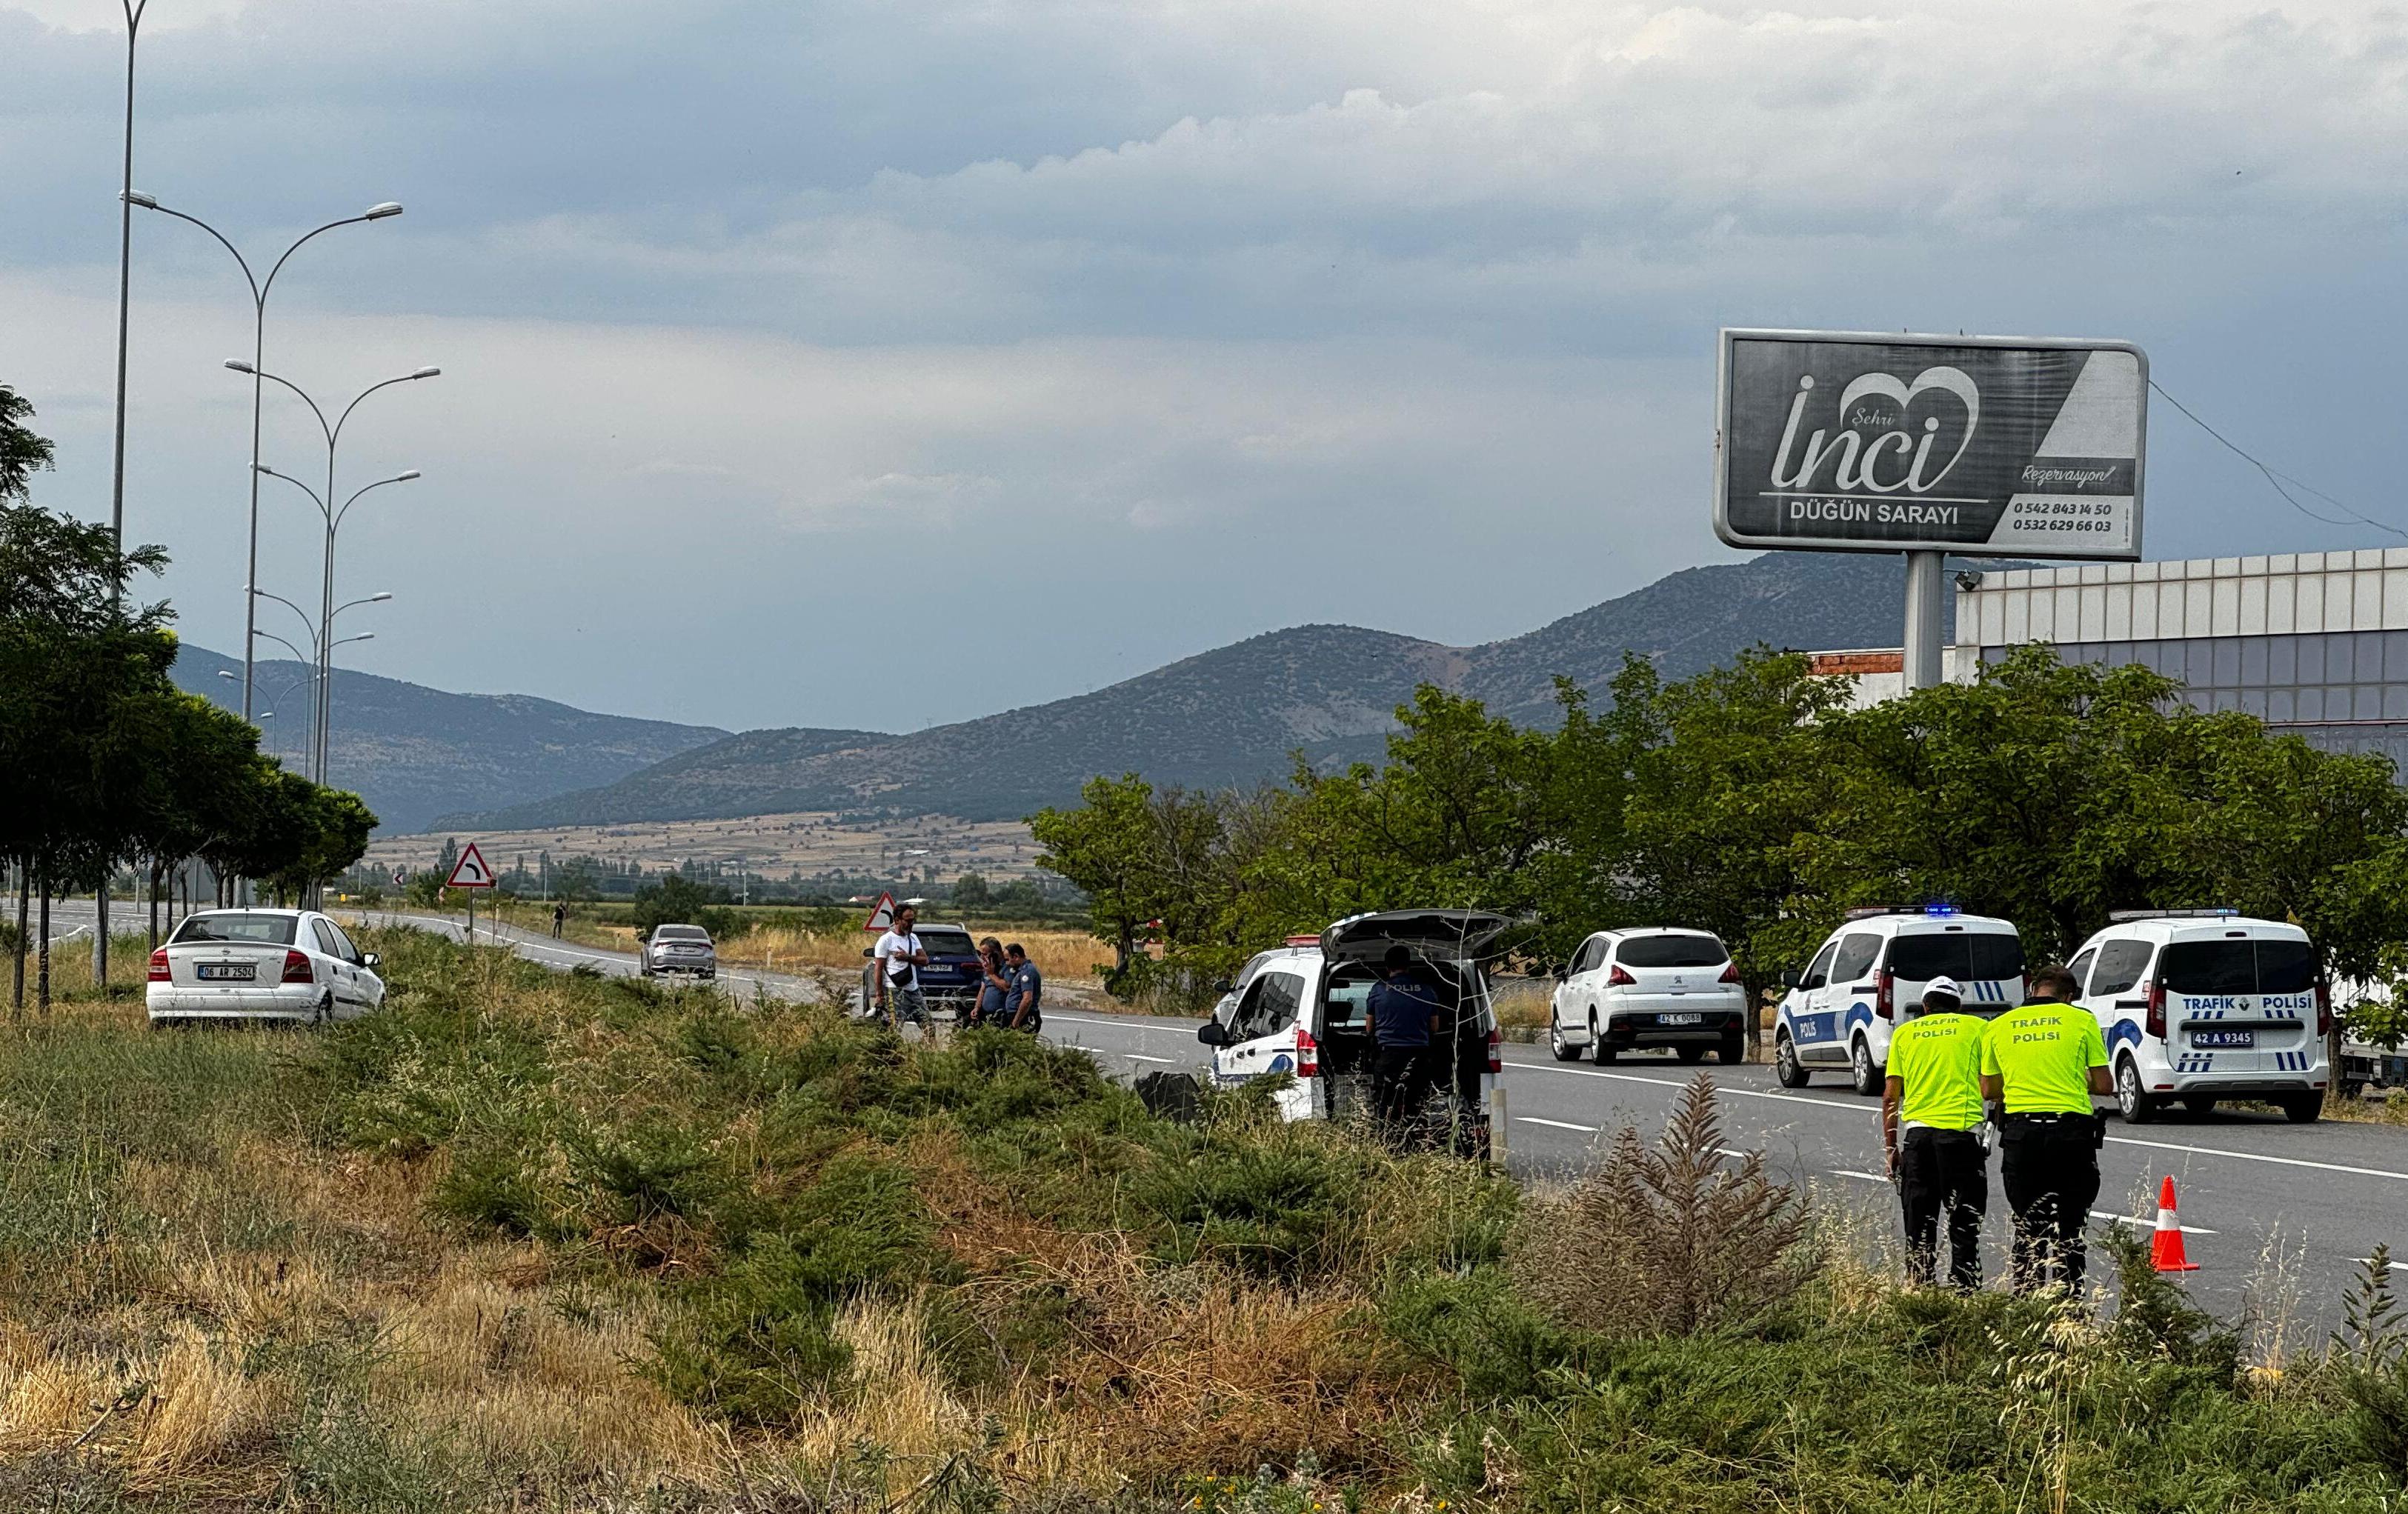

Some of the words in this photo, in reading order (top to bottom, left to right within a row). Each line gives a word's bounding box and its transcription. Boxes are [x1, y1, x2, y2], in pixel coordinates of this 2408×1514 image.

[1852, 407, 1894, 427] Şehri
[2021, 464, 2116, 488] Rezervasyon
[1790, 498, 1870, 522] DÜĞÜN
[1877, 504, 1958, 524] SARAYI
[2014, 502, 2023, 513] 0
[2024, 503, 2049, 514] 542
[2052, 504, 2076, 515] 843
[2079, 504, 2092, 515] 14
[2094, 504, 2112, 516] 50
[2023, 520, 2047, 530] 532
[2049, 520, 2074, 530] 629
[2076, 521, 2092, 531] 66
[2095, 521, 2111, 532] 03
[219, 967, 229, 976] AR
[2183, 995, 2235, 1010] TRAFİK
[2263, 993, 2312, 1009] POLİSİ
[2195, 1033, 2209, 1043] 42
[2212, 1033, 2221, 1043] A
[2224, 1033, 2251, 1043] 9345
